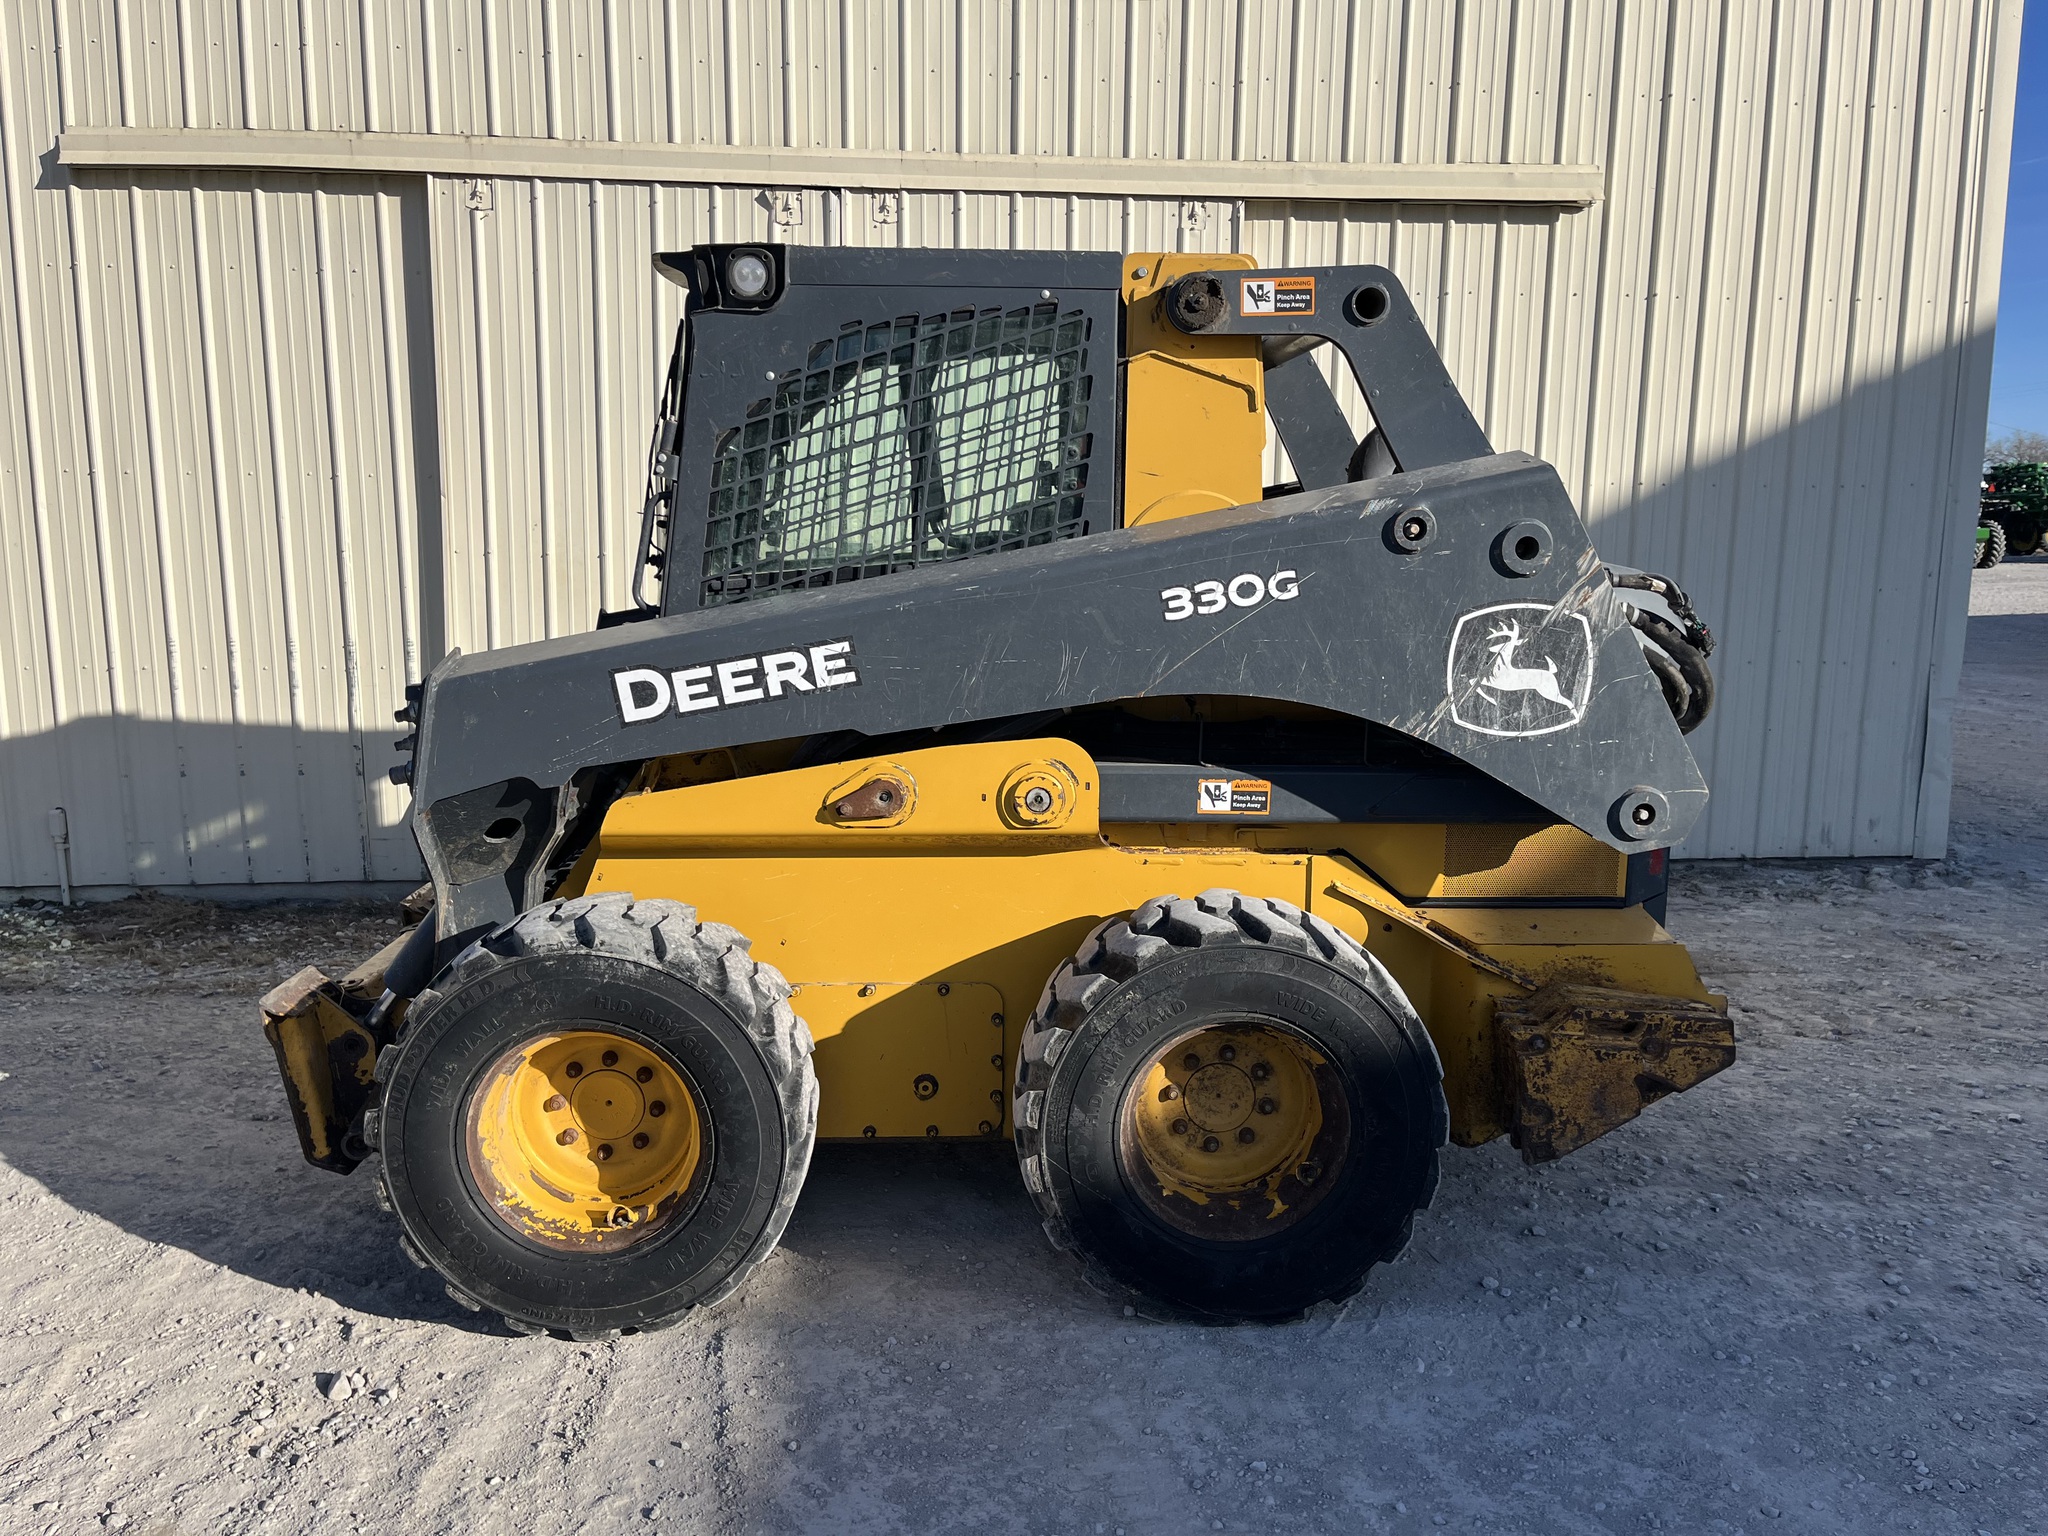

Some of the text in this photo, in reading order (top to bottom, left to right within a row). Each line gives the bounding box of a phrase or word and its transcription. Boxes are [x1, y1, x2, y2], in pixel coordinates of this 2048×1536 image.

[1161, 570, 1299, 621] 330G
[614, 641, 857, 723] DEERE
[407, 1006, 459, 1070] POWER
[455, 1016, 506, 1060] WALL
[1276, 991, 1327, 1023] WIDE
[640, 1008, 680, 1037] RIM
[681, 1035, 732, 1097] GUARD
[1097, 1050, 1126, 1087] RIM
[1123, 999, 1188, 1048] GUARD
